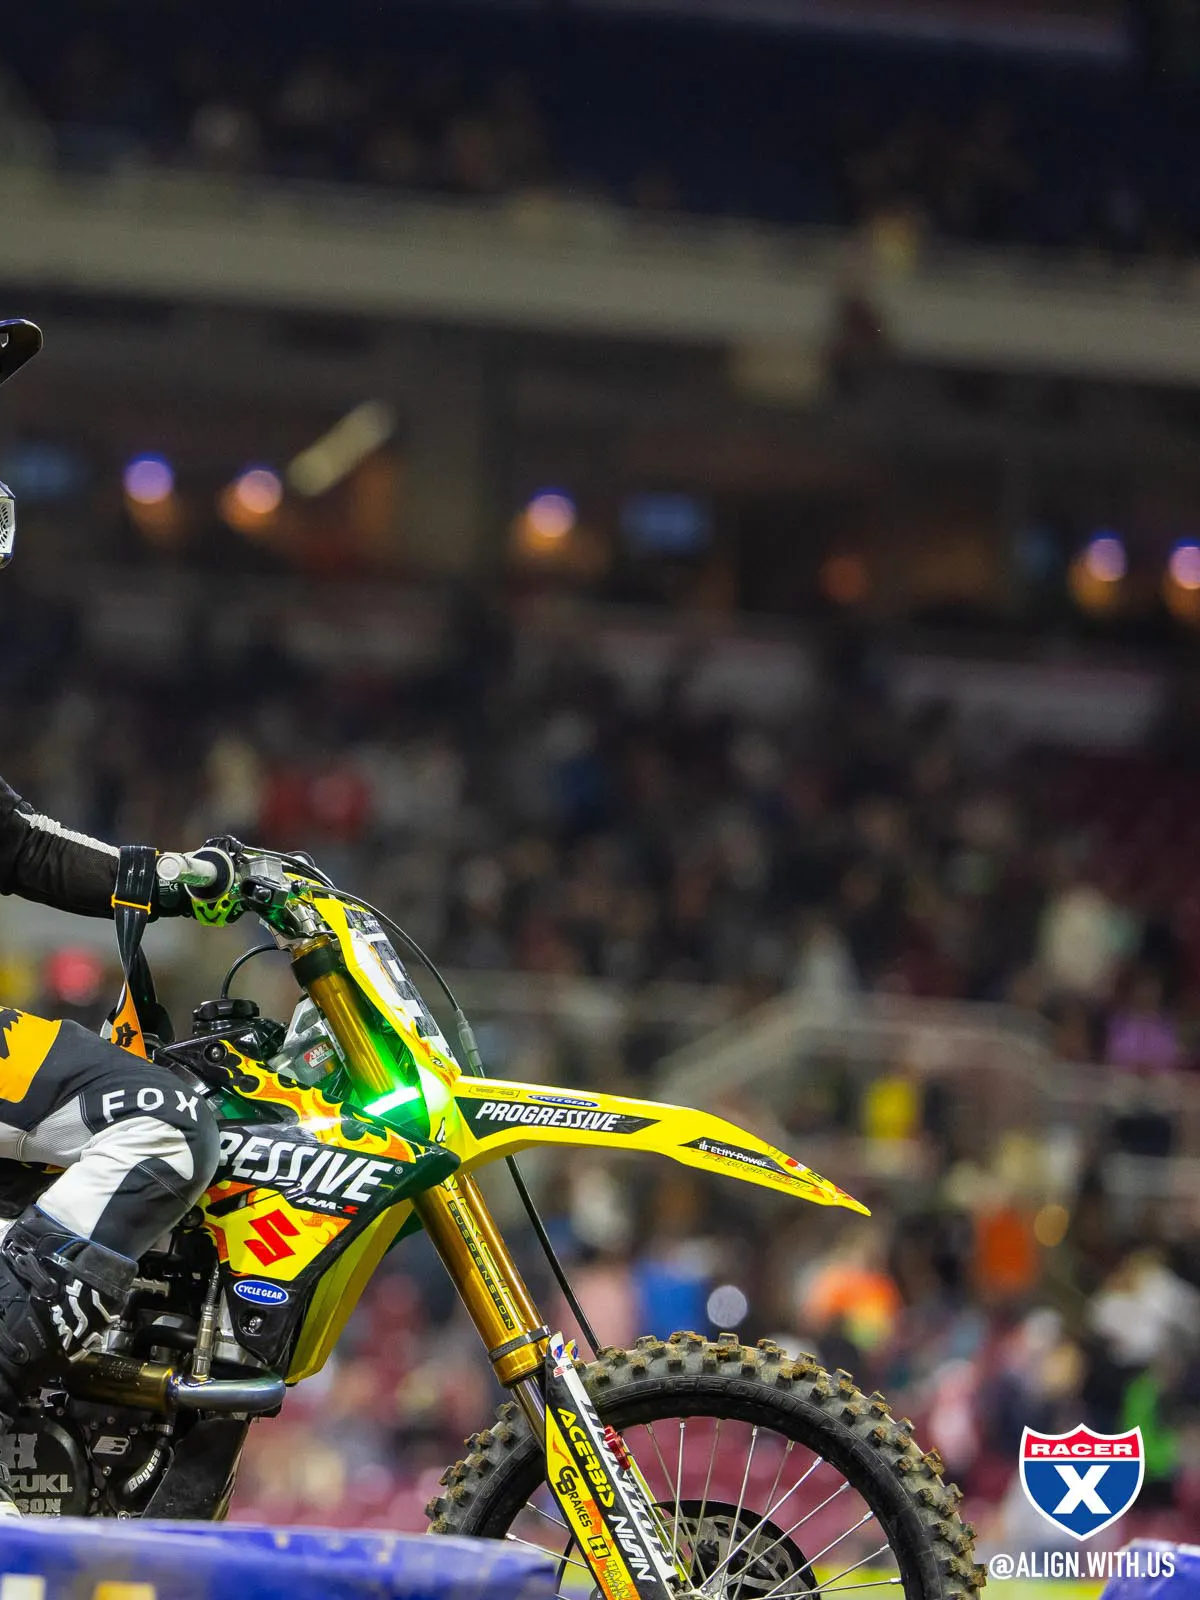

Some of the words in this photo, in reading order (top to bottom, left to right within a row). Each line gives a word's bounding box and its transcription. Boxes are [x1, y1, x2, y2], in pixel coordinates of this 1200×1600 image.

[102, 1087, 199, 1123] FOX
[475, 1101, 621, 1131] PROGRESSIVE
[448, 1200, 515, 1331] SUSPENSION
[237, 1284, 262, 1298] CYCLE
[261, 1288, 284, 1301] GEAR
[11, 1474, 69, 1493] ZUKI
[126, 1448, 161, 1492] Boyese
[16, 1498, 61, 1513] SON
